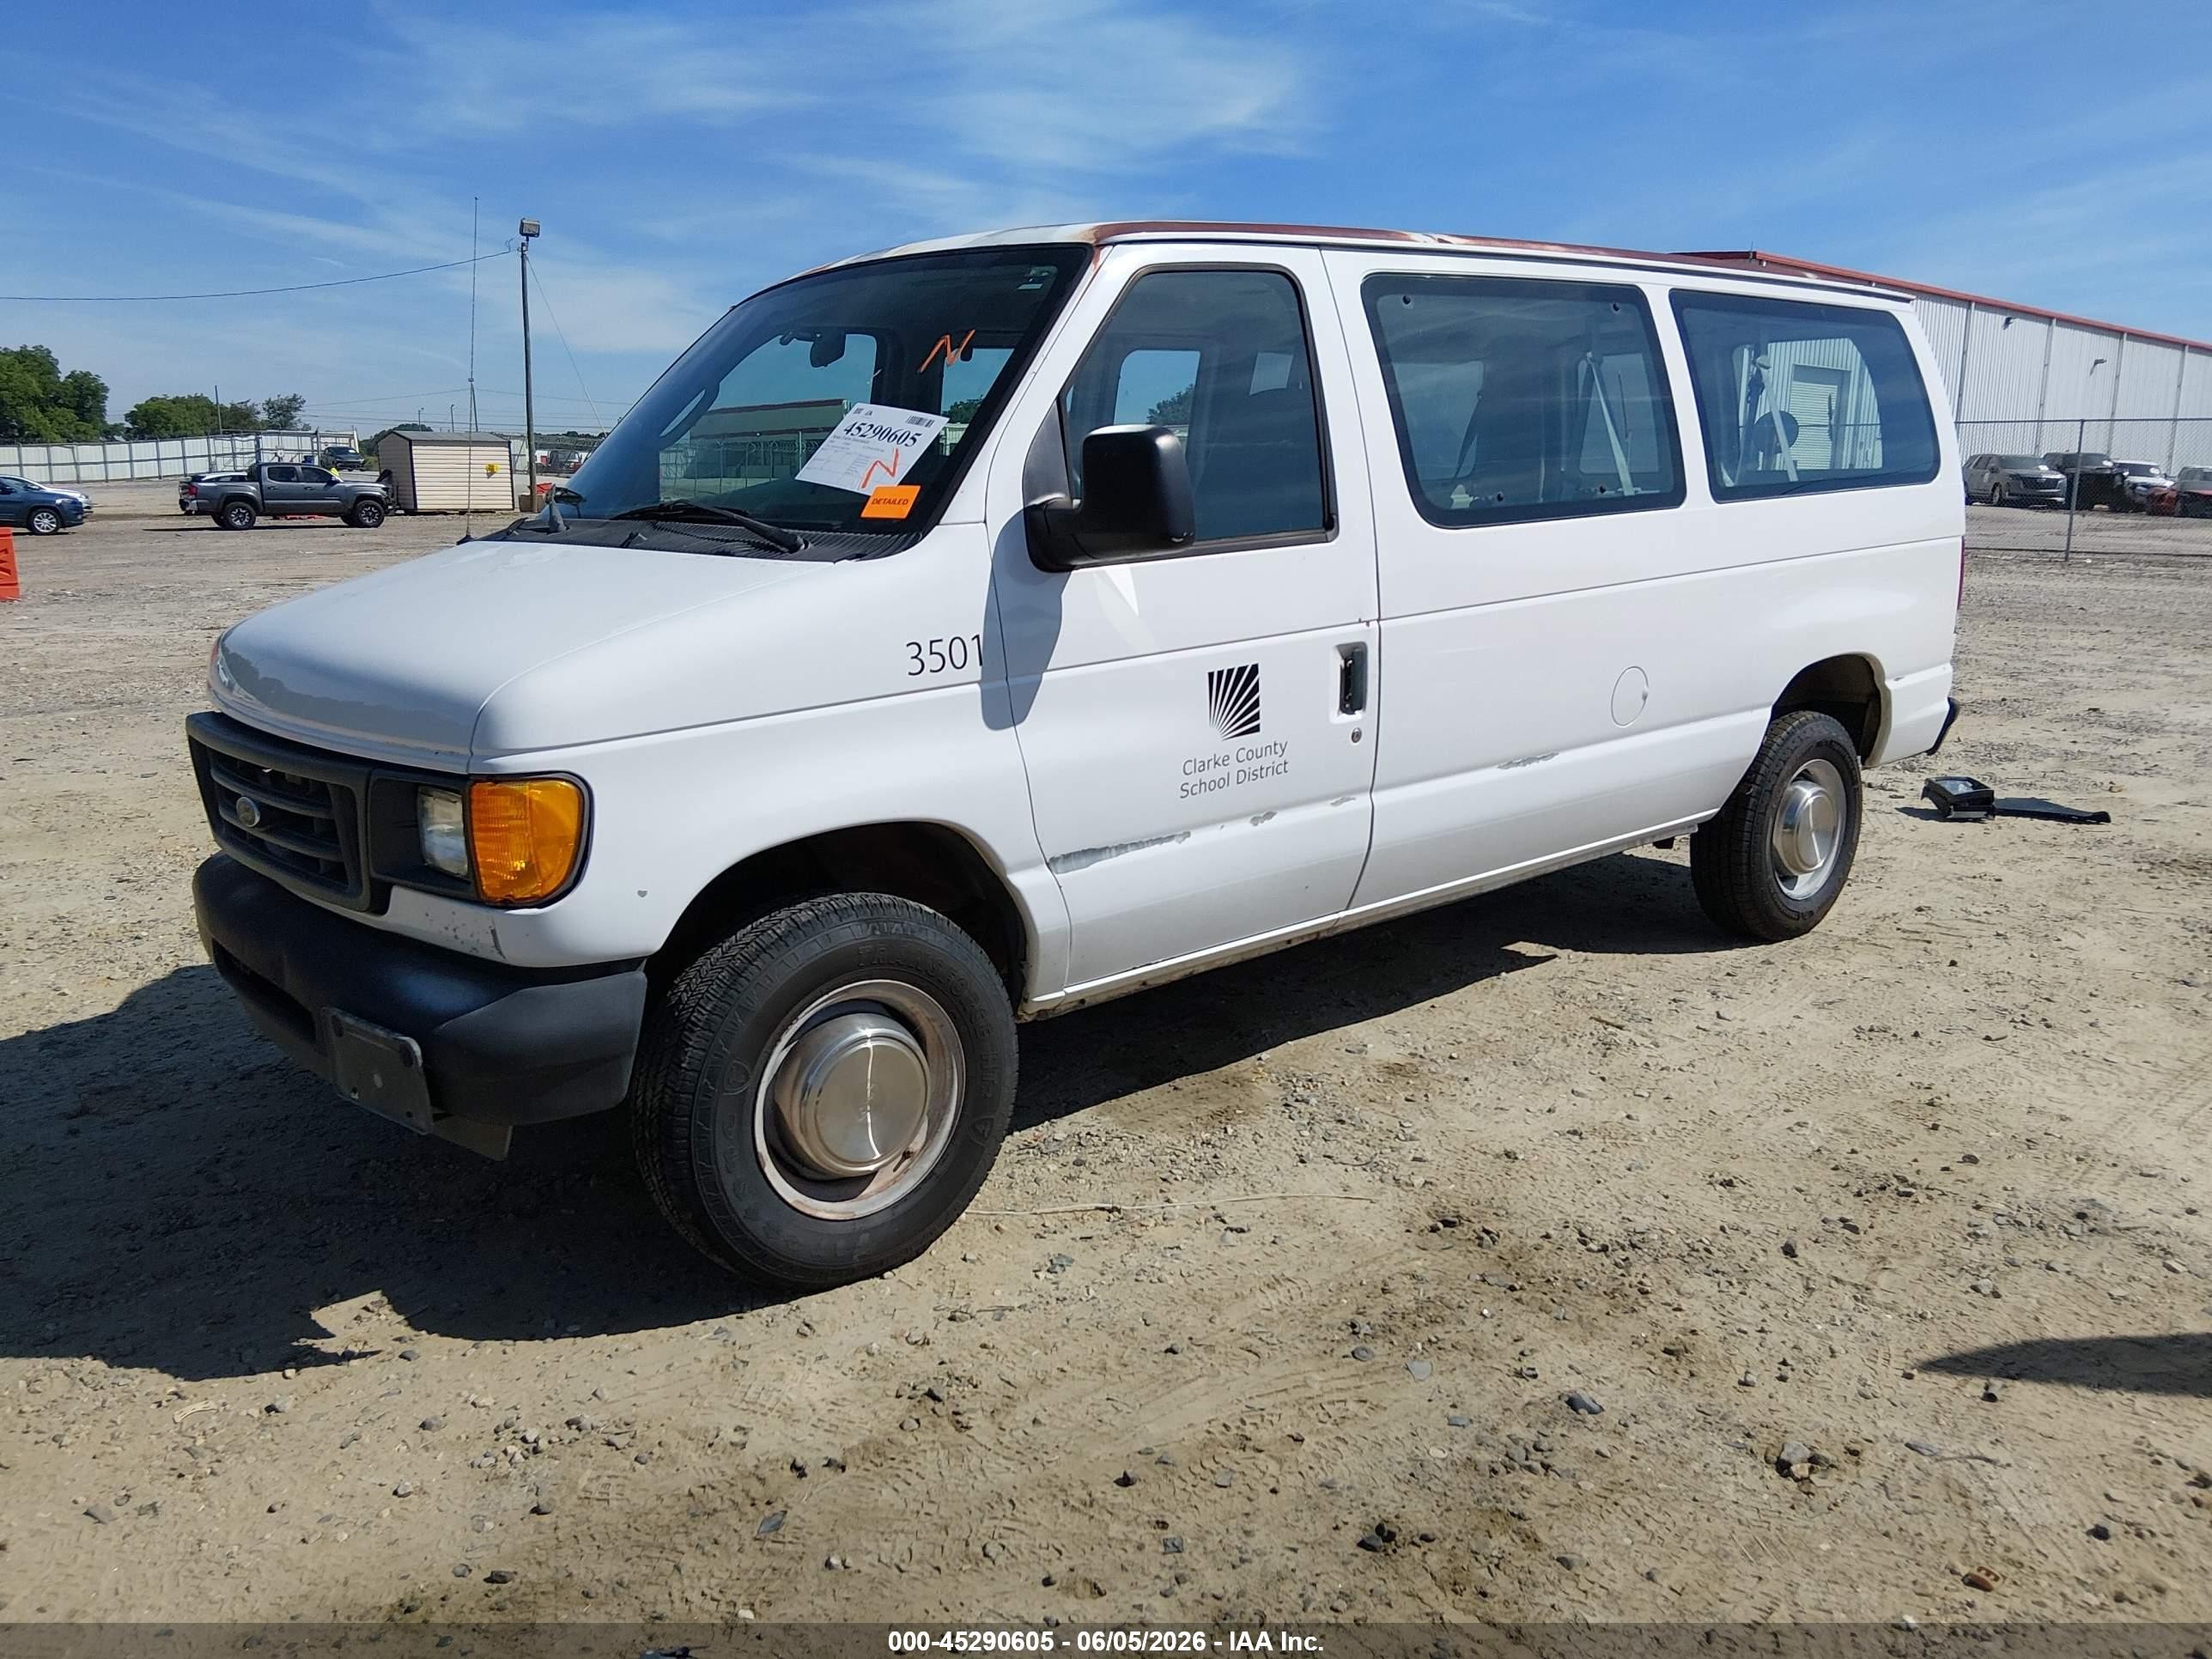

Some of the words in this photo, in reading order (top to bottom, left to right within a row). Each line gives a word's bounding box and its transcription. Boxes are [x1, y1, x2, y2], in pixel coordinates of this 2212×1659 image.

[843, 420, 923, 447] 45290605
[871, 496, 910, 507] DETAILED
[906, 634, 983, 677] 3501
[1182, 753, 1231, 776] Clarke
[1236, 740, 1288, 764] County
[1179, 772, 1230, 799] School
[1237, 759, 1289, 785] District
